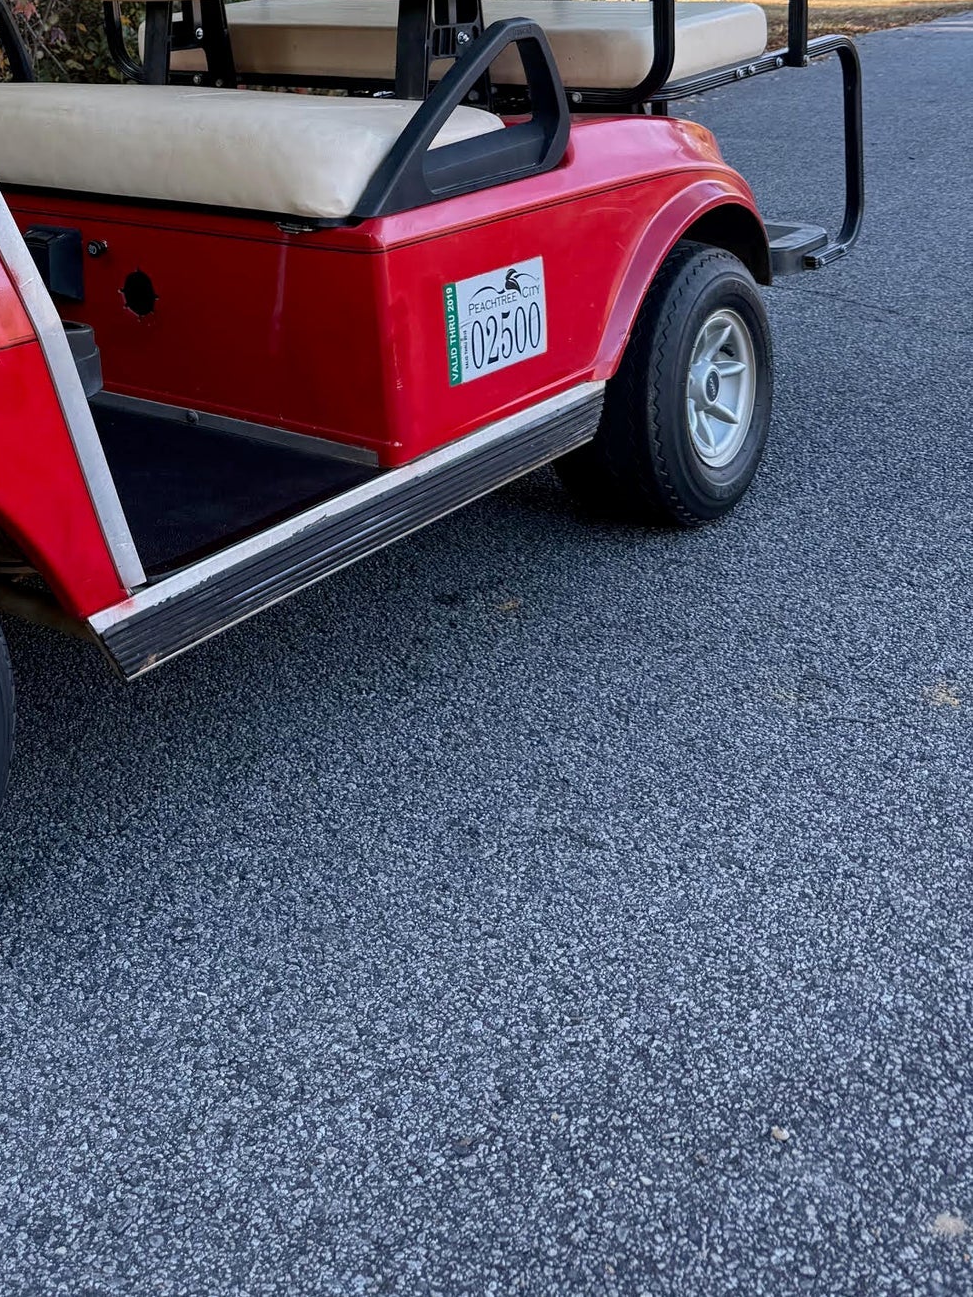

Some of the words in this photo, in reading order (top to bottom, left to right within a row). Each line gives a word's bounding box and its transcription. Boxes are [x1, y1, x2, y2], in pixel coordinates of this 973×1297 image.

[446, 287, 454, 312] 2019
[468, 292, 517, 316] PEACHTREE
[521, 285, 540, 298] CITY
[447, 315, 457, 344] THRU
[471, 302, 541, 369] 02500
[450, 348, 458, 381] VALID
